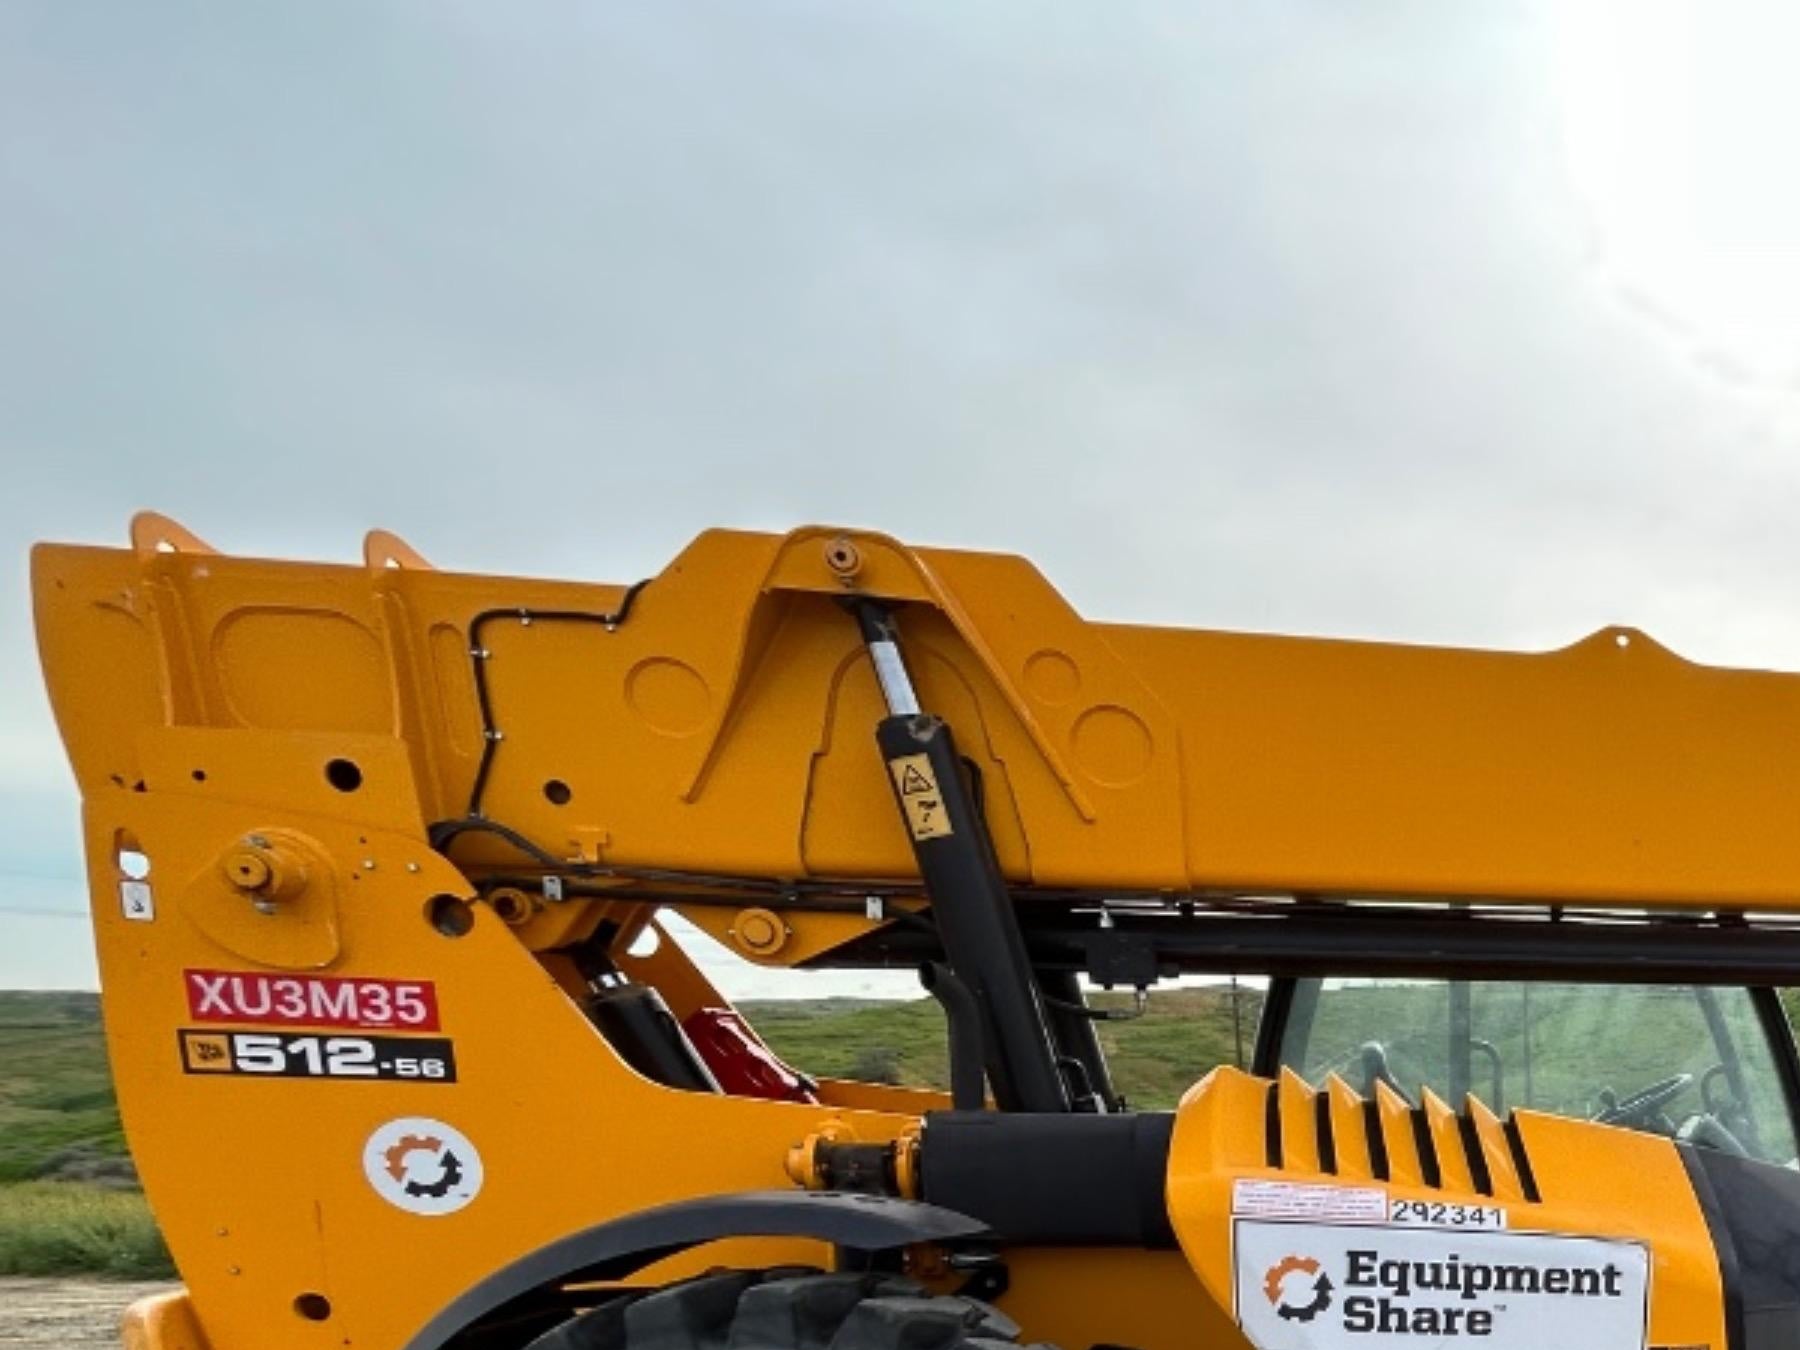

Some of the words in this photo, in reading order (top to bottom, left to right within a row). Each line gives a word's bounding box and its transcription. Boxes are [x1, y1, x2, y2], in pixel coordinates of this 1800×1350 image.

[191, 973, 428, 1026] XU3M35
[1391, 1199, 1502, 1227] 292341
[1343, 1250, 1623, 1300] Equipment
